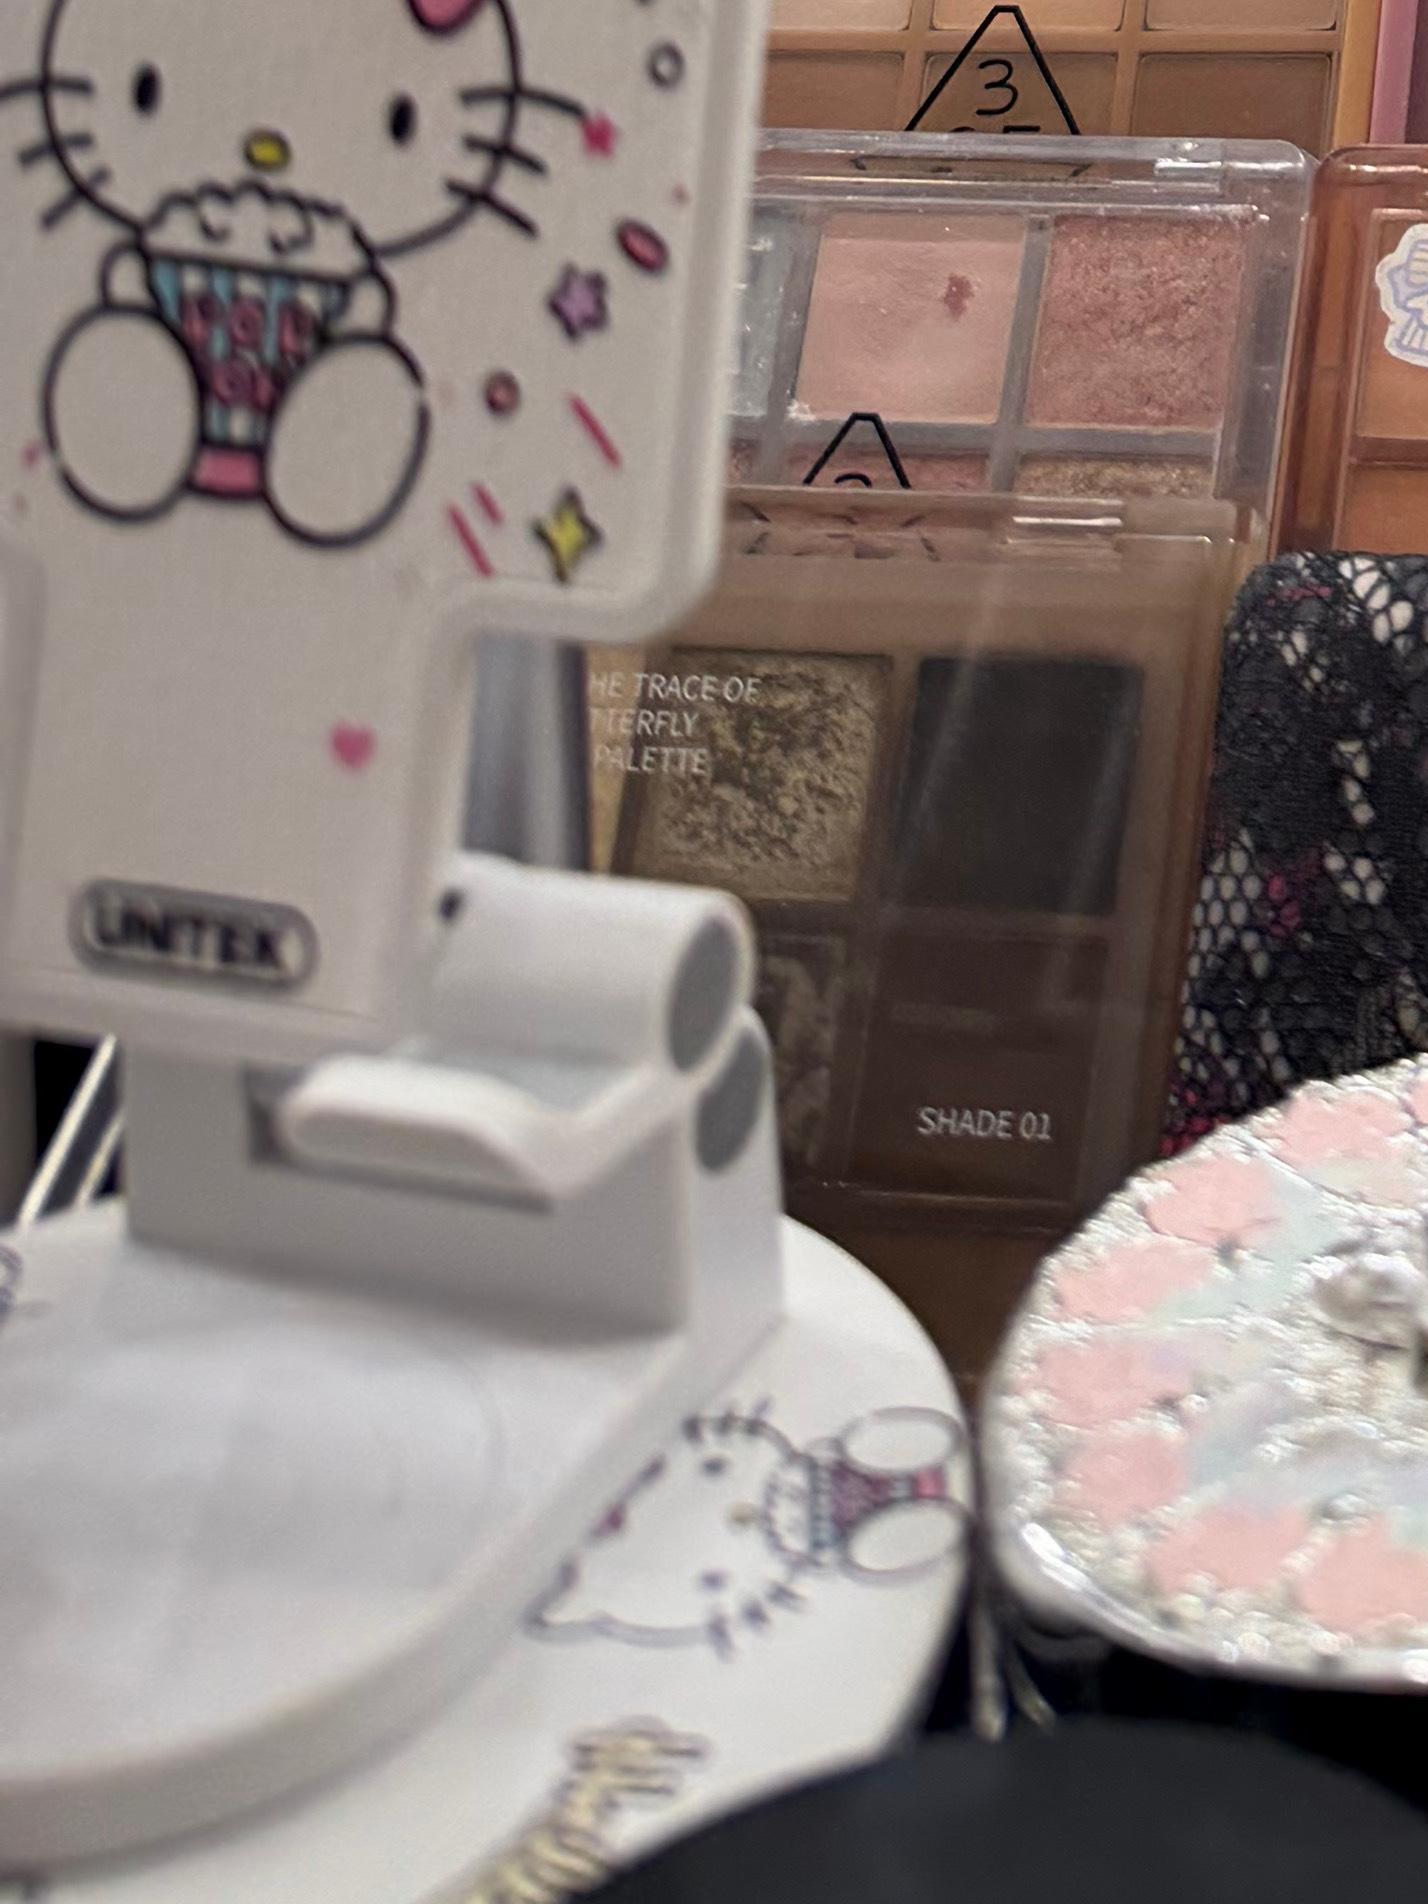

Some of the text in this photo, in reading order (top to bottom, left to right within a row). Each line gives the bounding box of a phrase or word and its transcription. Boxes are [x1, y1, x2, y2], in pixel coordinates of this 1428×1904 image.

[975, 58, 1019, 116] 3
[635, 673, 720, 701] TRACE
[723, 676, 763, 703] OF
[916, 1106, 1052, 1141] SHADE 01
